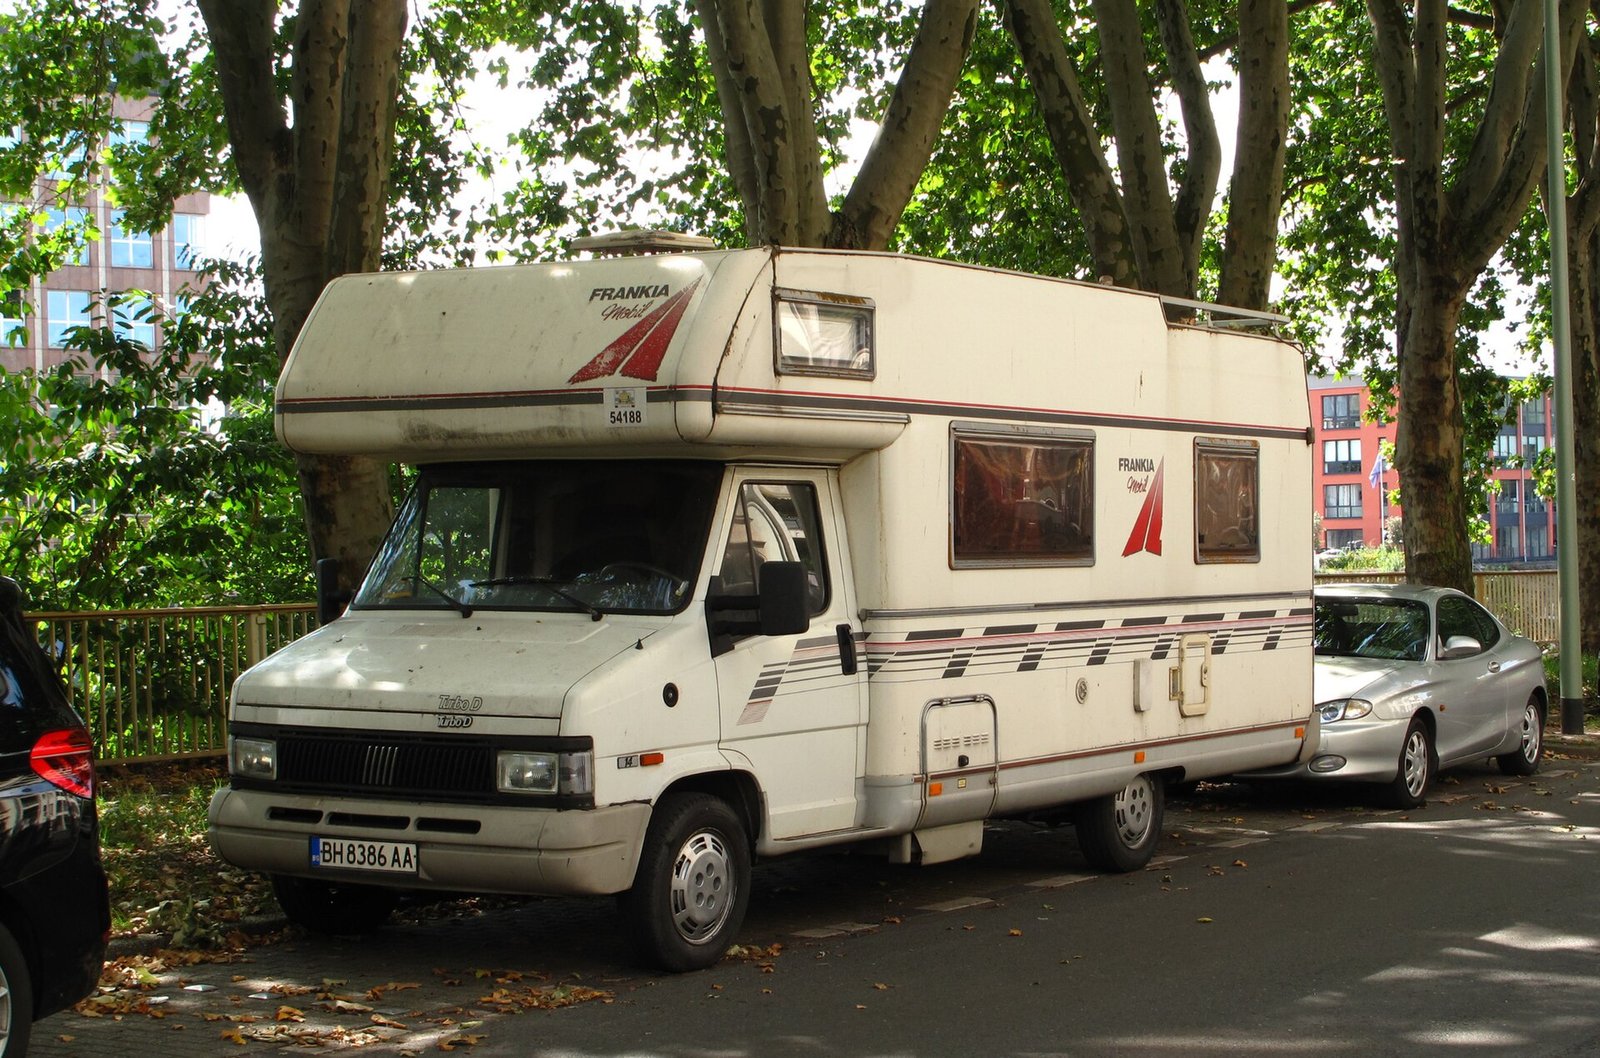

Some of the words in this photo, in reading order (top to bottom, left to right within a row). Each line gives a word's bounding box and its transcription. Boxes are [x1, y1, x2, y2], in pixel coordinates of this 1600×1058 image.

[588, 284, 670, 302] FRANKIA
[601, 299, 654, 321] Mobil
[610, 410, 642, 424] 54188
[1118, 457, 1155, 472] FRANKIA
[1127, 474, 1149, 494] Mobil
[438, 694, 470, 711] Turbo
[469, 696, 483, 711] D
[437, 713, 462, 728] Turbo
[462, 714, 474, 728] D
[322, 841, 344, 864] BH
[346, 843, 387, 867] 8386
[391, 846, 413, 868] AA
